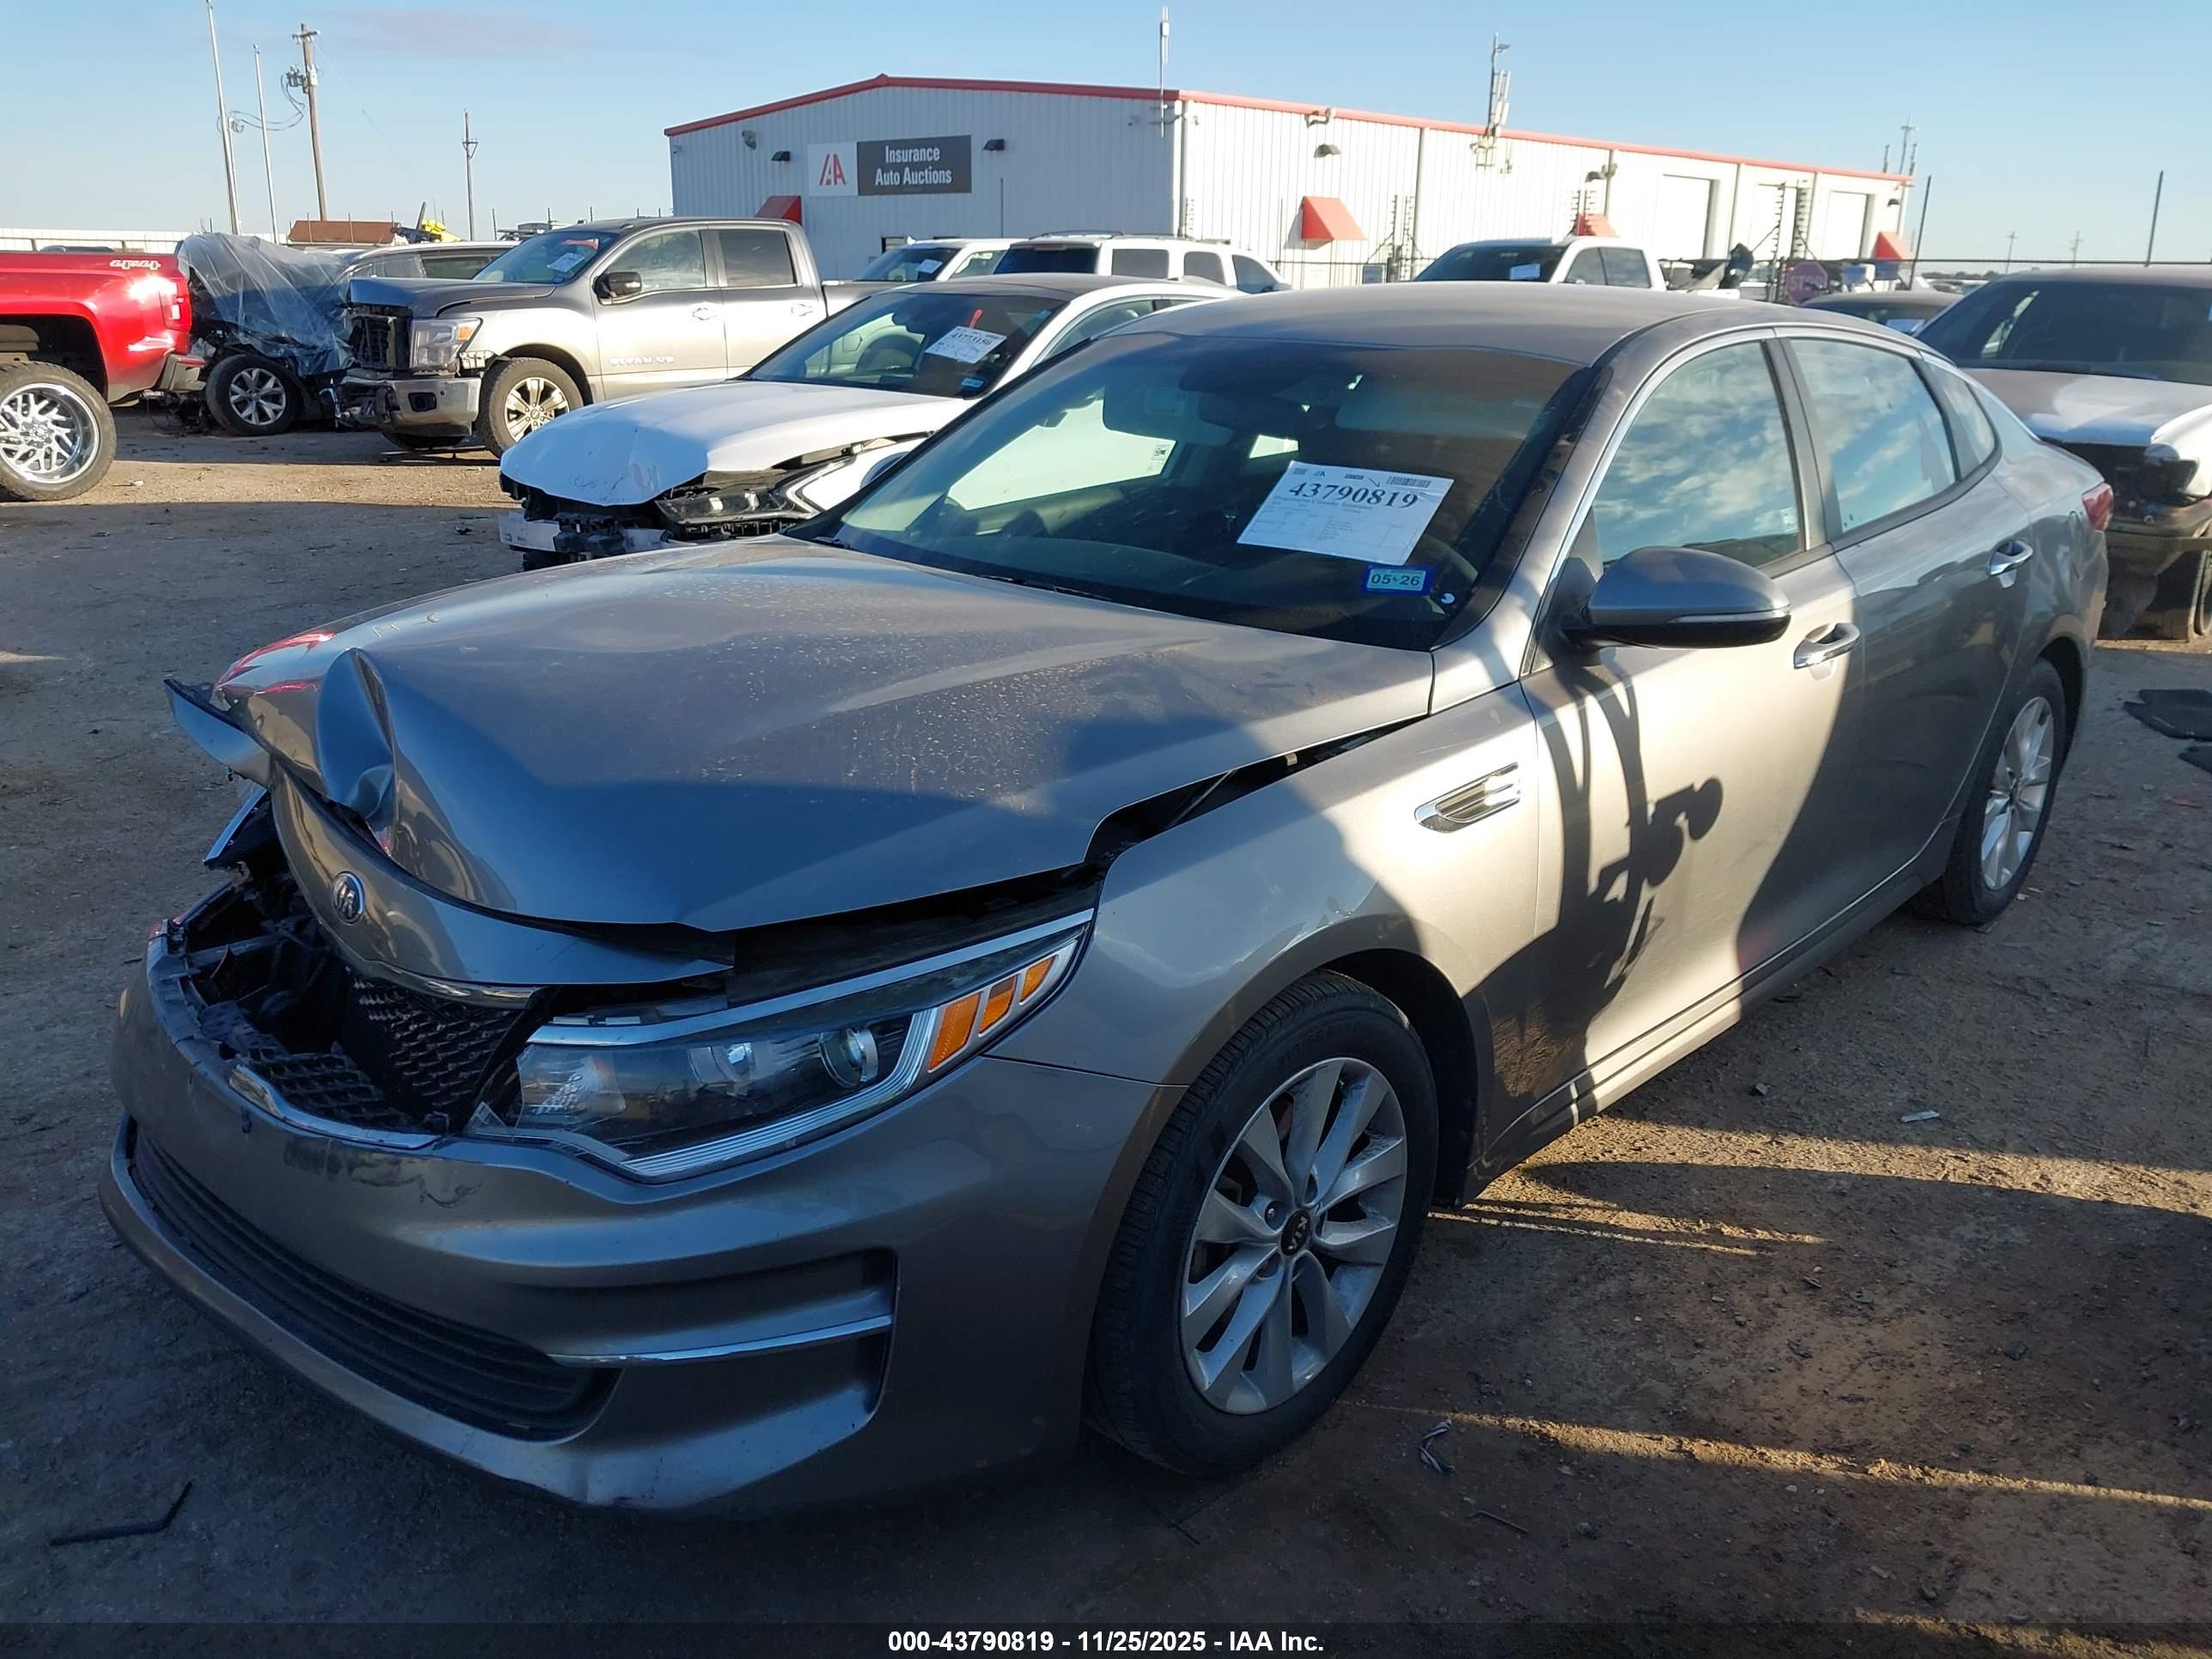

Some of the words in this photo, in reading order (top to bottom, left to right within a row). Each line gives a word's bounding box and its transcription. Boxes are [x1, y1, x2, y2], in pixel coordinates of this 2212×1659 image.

[885, 145, 940, 163] Insurance
[874, 168, 900, 186] Auto
[903, 166, 952, 185] Auctions
[1289, 481, 1419, 508] 43790819
